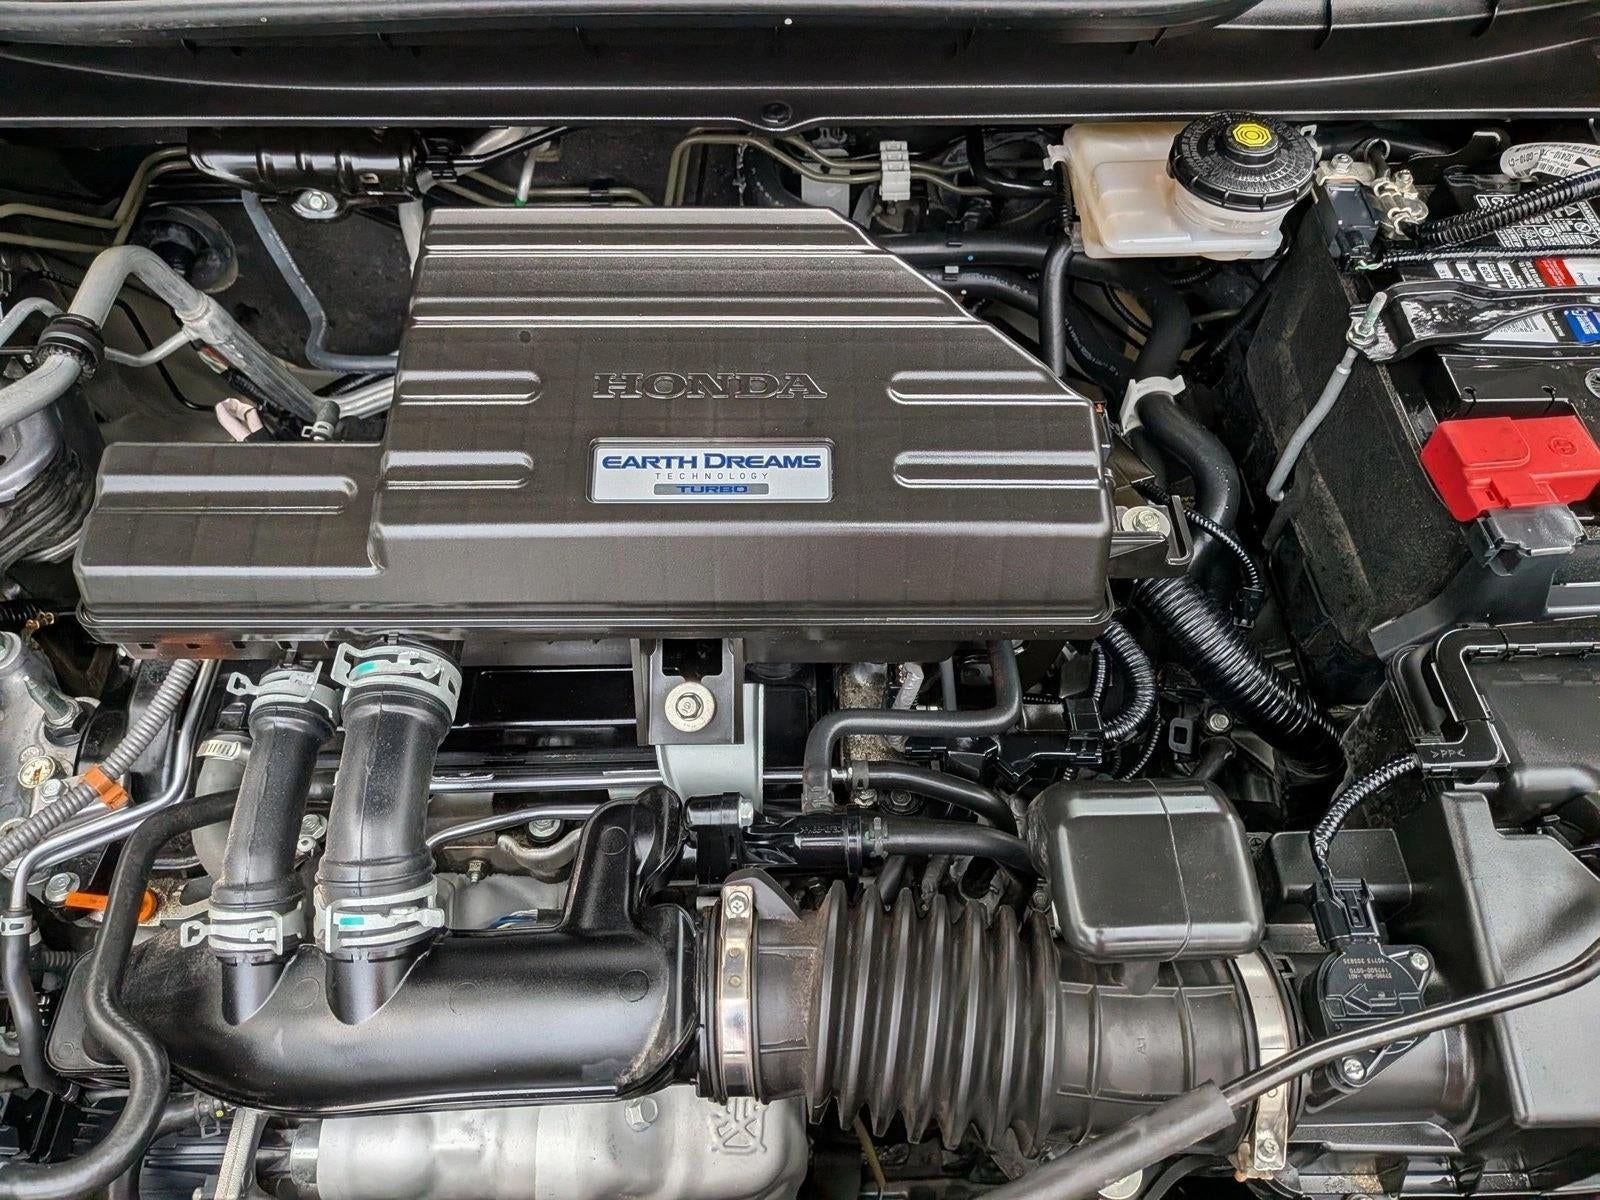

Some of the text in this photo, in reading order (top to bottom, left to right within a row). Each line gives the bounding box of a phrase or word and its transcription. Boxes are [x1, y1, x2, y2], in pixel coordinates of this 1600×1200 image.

[592, 372, 828, 399] HONDA
[602, 453, 822, 470] EARTH DREAMS
[676, 485, 748, 493] TURBO
